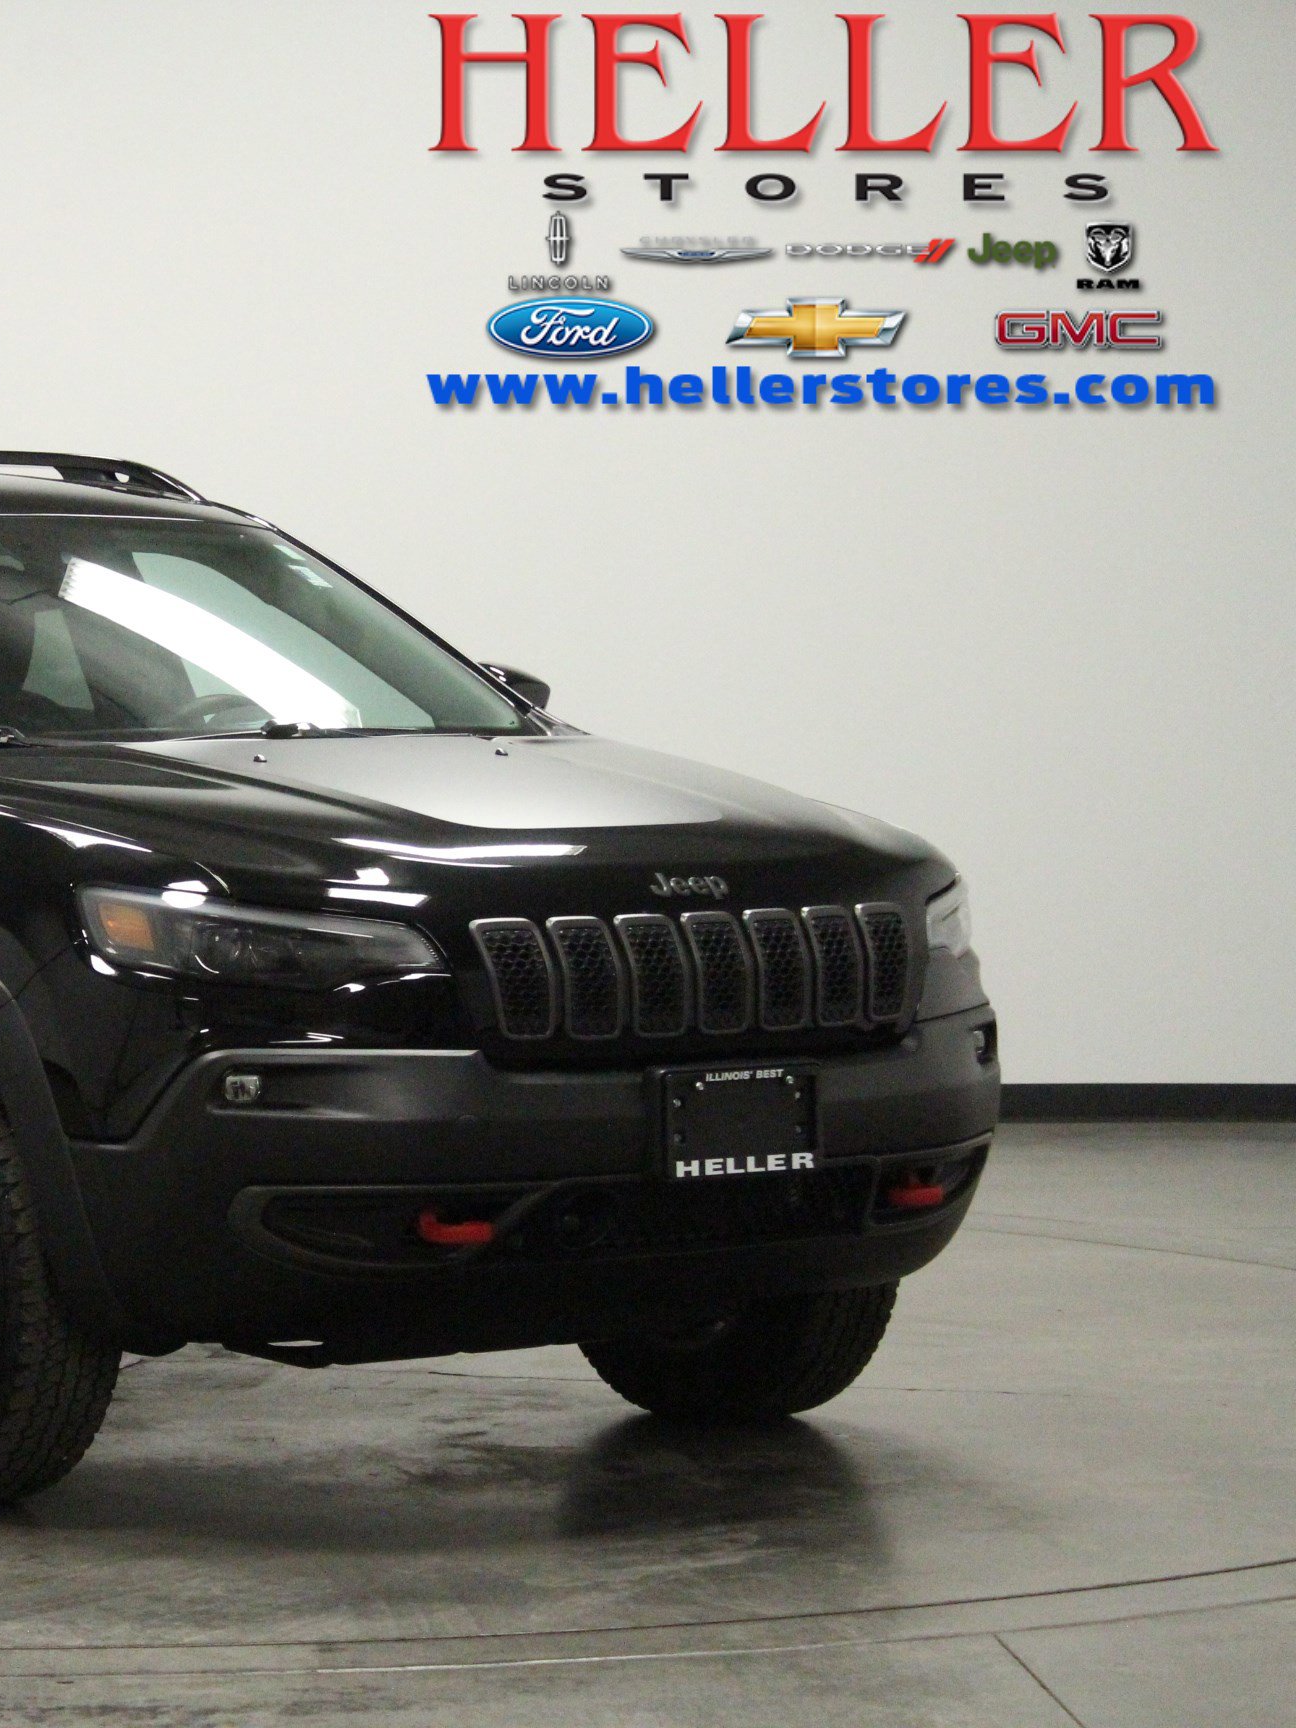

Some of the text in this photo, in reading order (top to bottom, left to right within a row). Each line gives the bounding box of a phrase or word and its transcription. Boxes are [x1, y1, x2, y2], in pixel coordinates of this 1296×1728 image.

[650, 872, 729, 900] Jeep
[756, 1068, 784, 1079] BEST
[675, 1151, 815, 1178] HELLER
